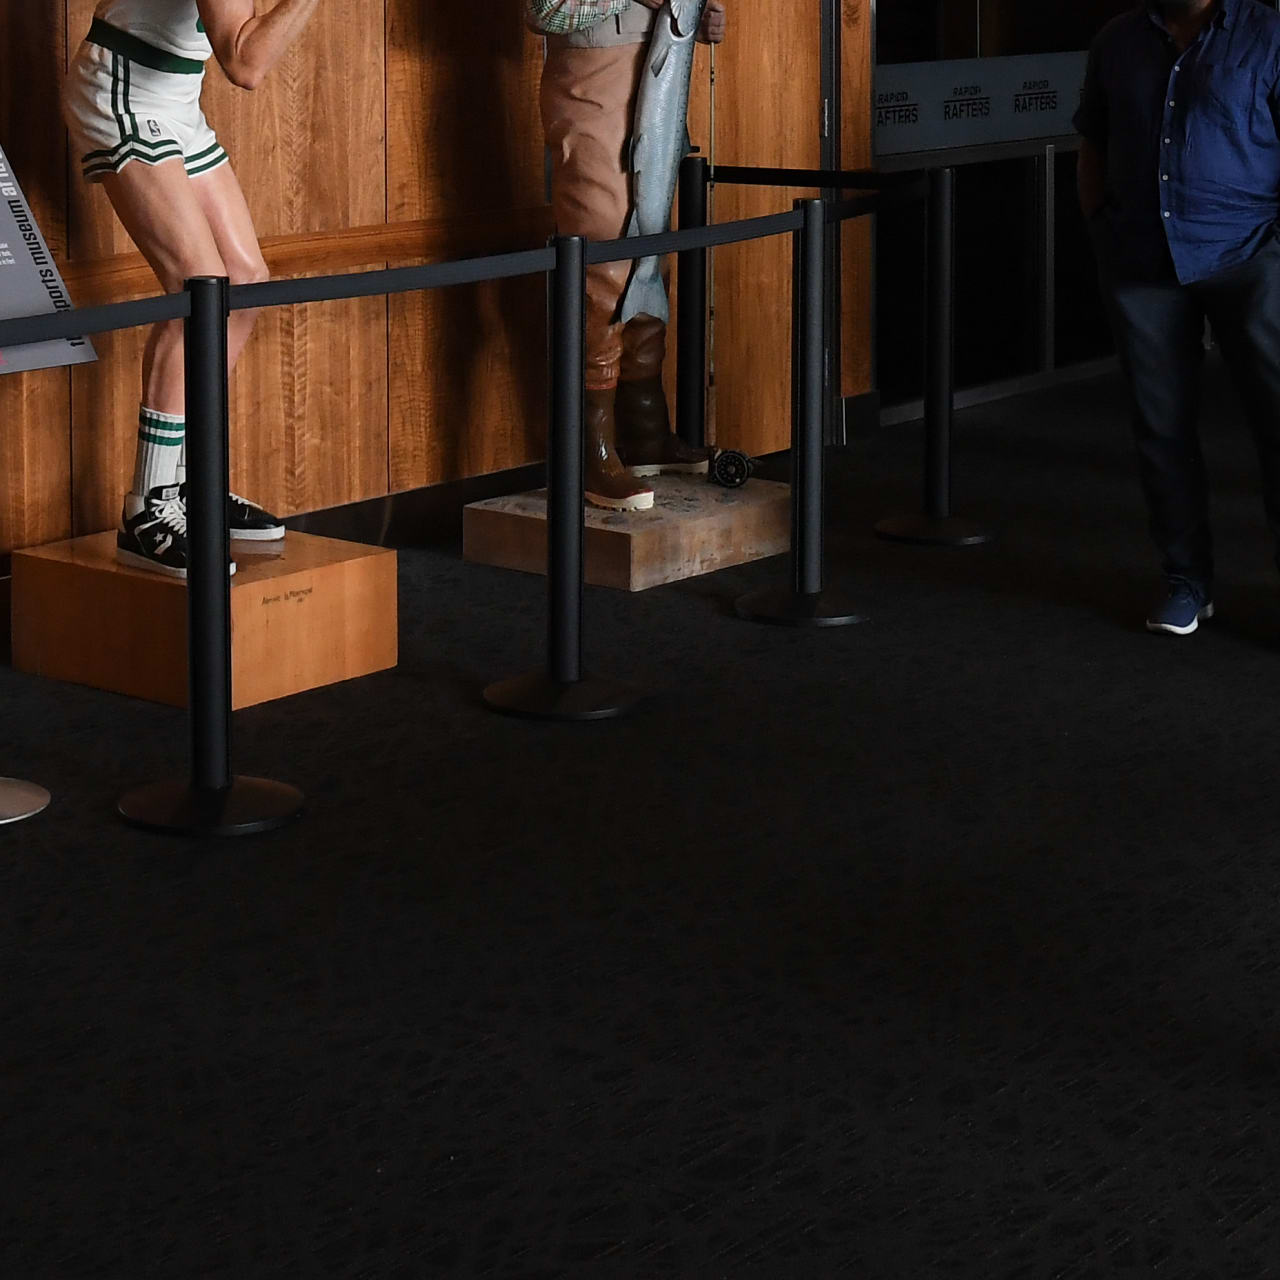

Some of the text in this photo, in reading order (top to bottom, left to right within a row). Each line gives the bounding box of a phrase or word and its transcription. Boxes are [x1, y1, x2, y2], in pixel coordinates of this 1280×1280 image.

[944, 101, 990, 120] RAFTERS
[1014, 95, 1057, 113] RAFTERS
[876, 107, 918, 127] AFTERS
[8, 199, 48, 266] museum
